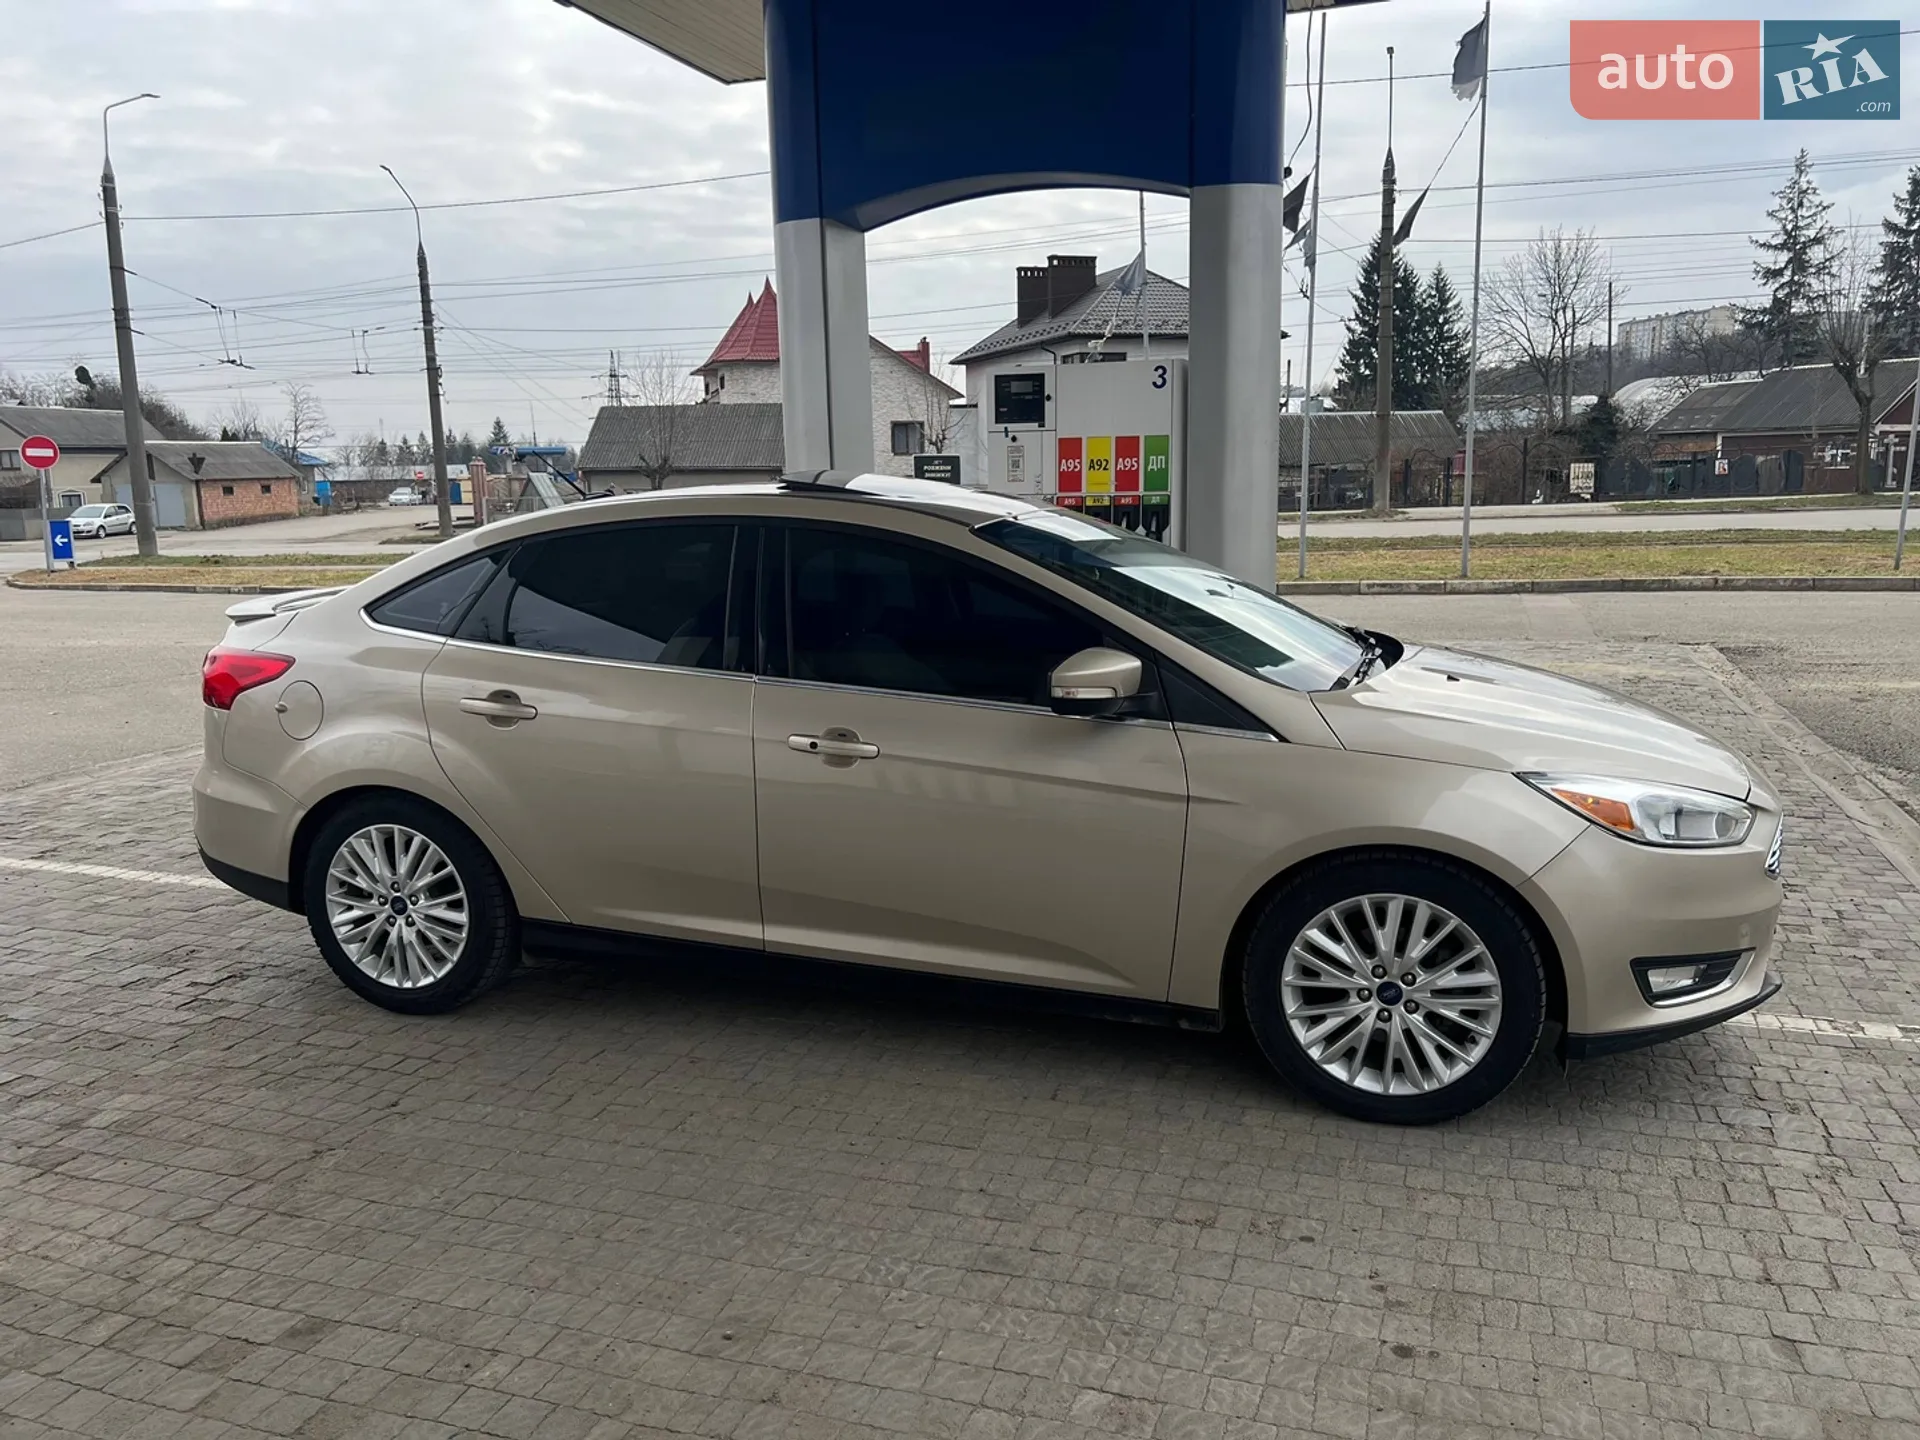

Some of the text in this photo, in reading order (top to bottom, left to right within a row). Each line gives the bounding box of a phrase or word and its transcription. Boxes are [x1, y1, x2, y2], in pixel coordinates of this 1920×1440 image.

[1152, 365, 1168, 389] 3
[1060, 458, 1081, 472] А95
[1088, 458, 1109, 471] А92
[1116, 457, 1138, 471] А95
[1147, 455, 1166, 472] ДП
